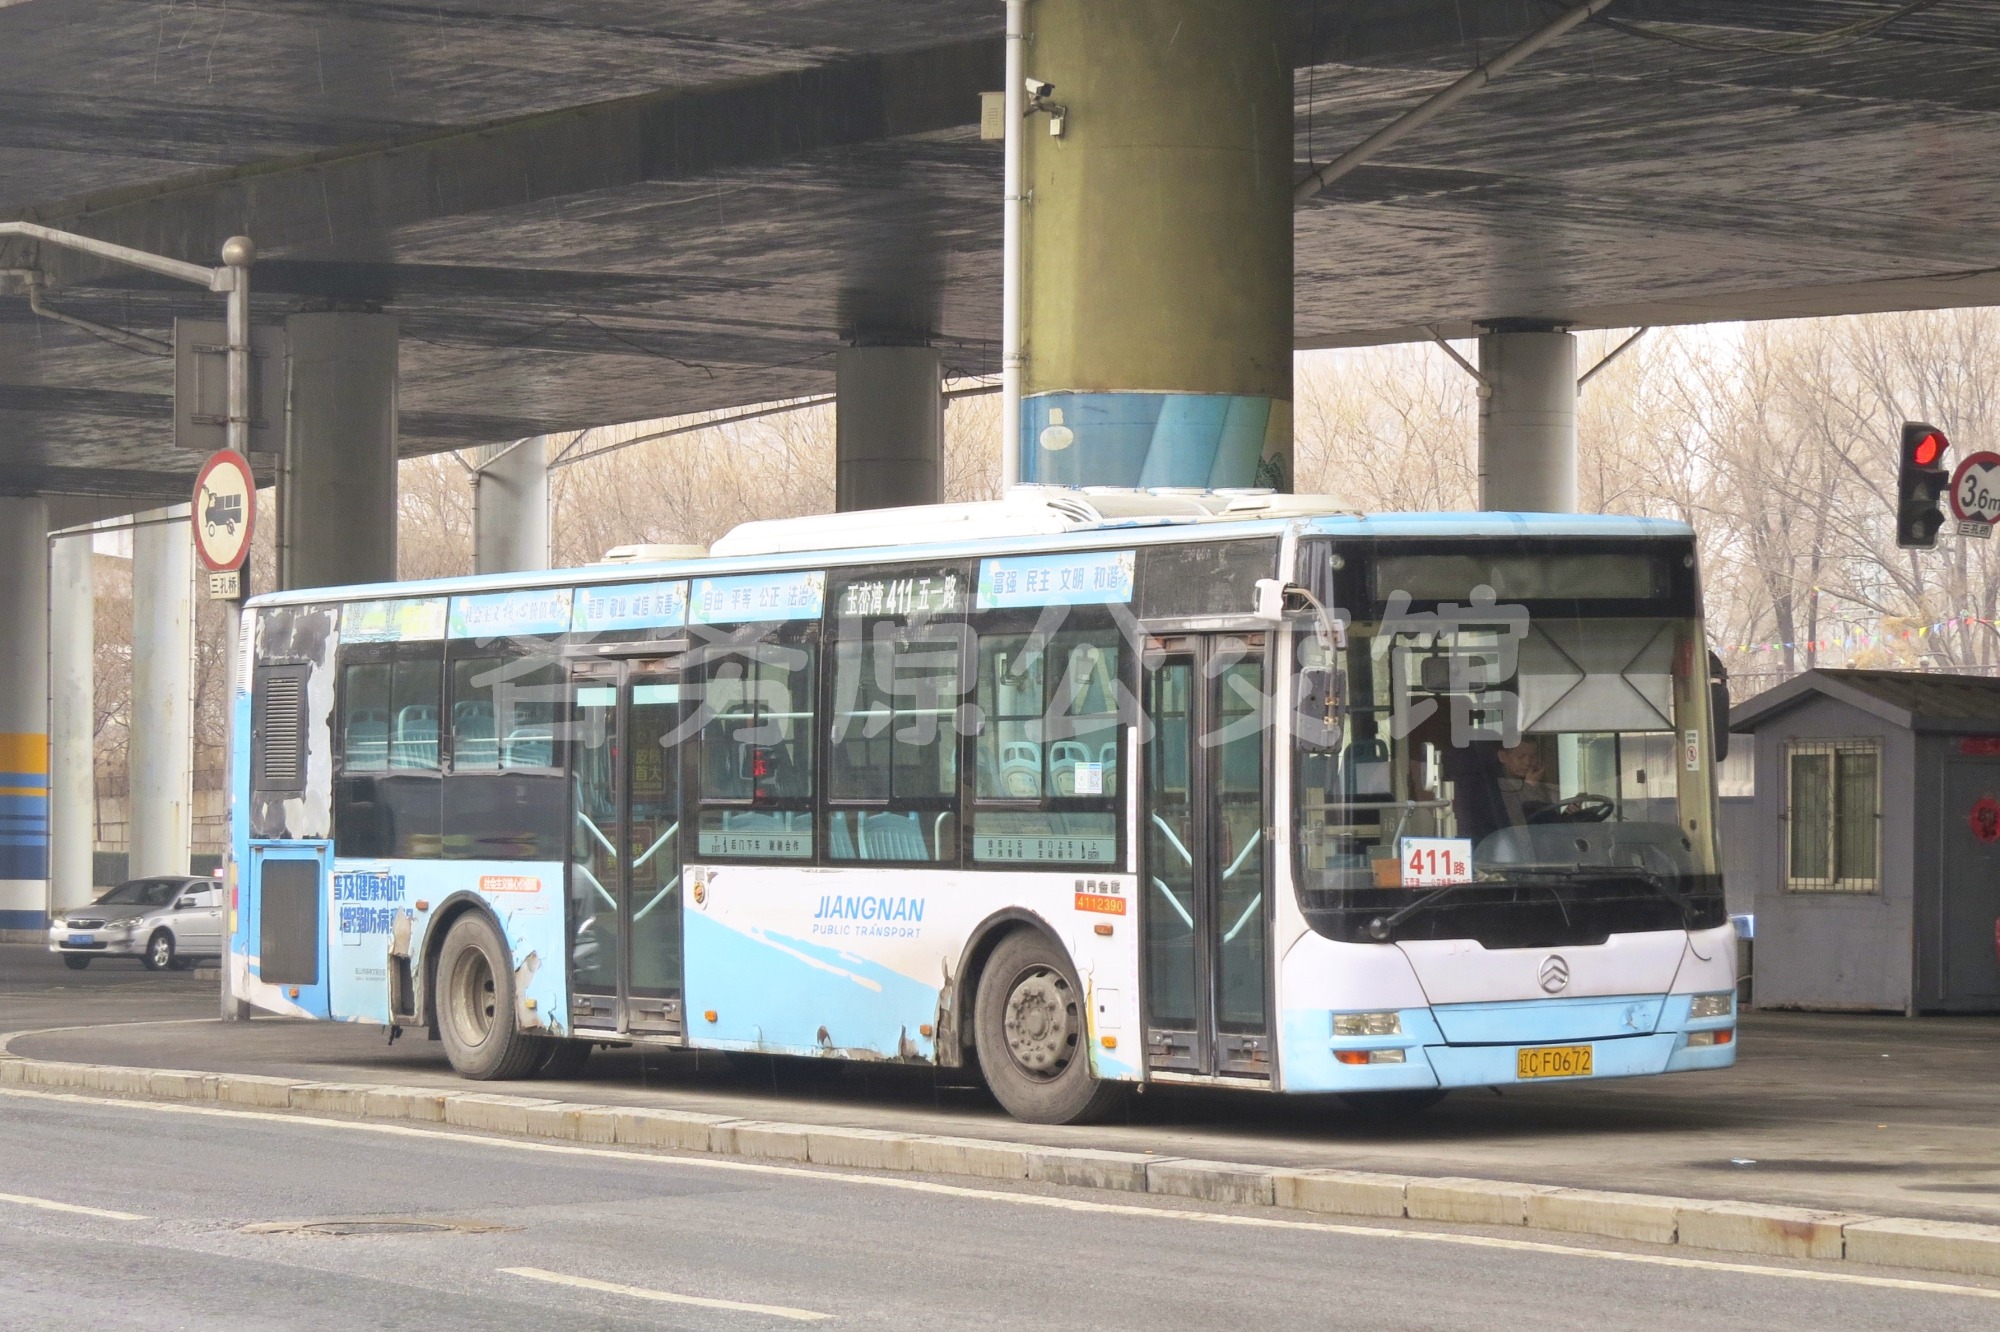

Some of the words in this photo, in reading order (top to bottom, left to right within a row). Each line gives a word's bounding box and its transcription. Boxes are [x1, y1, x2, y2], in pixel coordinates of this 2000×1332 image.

[1962, 474, 2000, 510] 3.6m
[1961, 523, 1989, 535] 三孔桥
[211, 576, 237, 594] 三孔桥
[993, 569, 1017, 594] 富强
[1026, 568, 1050, 592] 民主
[1059, 567, 1083, 591] 文明
[1093, 565, 1119, 590] 和谐
[588, 598, 604, 619] 爱国
[610, 596, 626, 618] 敬业
[632, 594, 649, 617] 诚信
[655, 593, 673, 615] 友善
[703, 590, 723, 611] 自由
[731, 588, 752, 609] 平等
[759, 586, 780, 608] 公正
[787, 585, 809, 607] 法治
[886, 577, 914, 615] 411
[917, 574, 957, 611] 五一路
[814, 895, 925, 922] JIANGNAN
[1078, 896, 1123, 912] 4112390
[812, 924, 850, 935] PUBLIC
[855, 925, 921, 938] TRANSPORT
